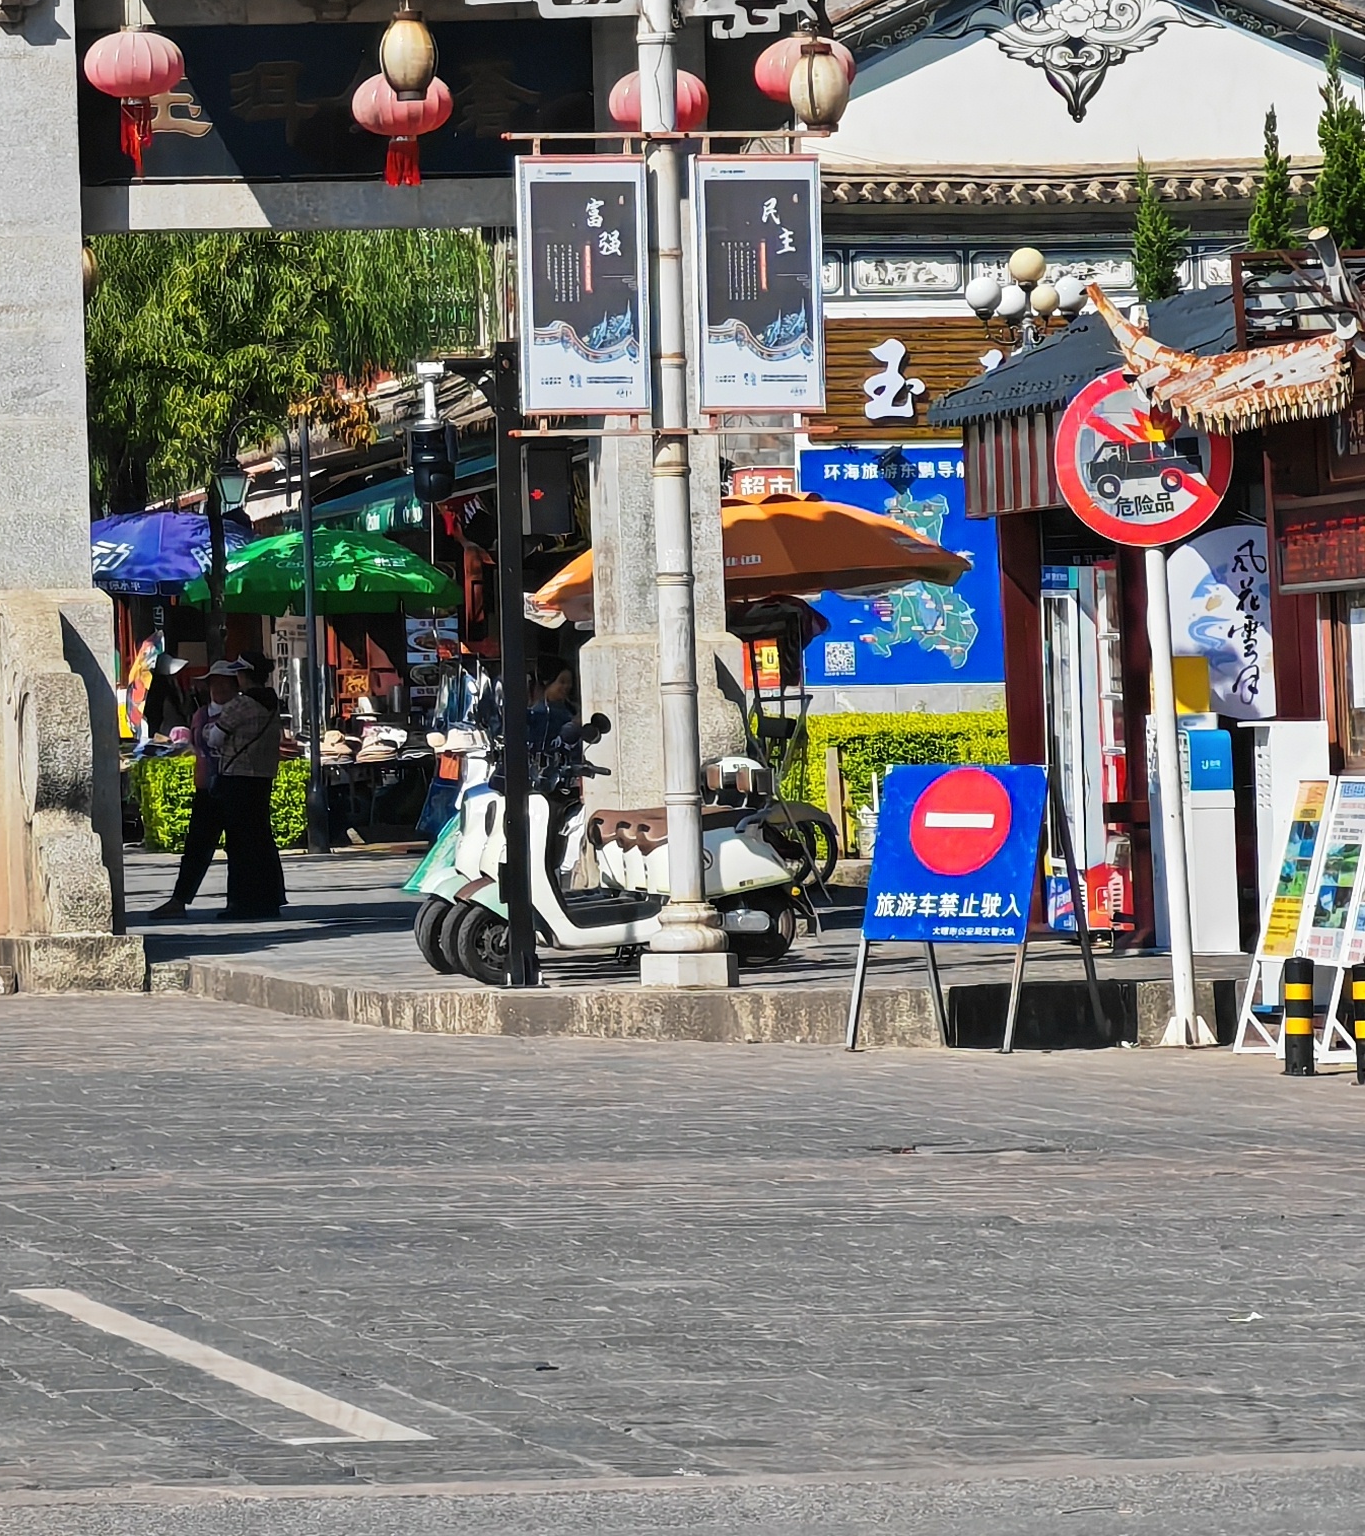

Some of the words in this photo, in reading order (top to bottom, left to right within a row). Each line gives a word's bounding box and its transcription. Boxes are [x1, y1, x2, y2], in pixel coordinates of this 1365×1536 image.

[585, 197, 622, 256] 富强
[761, 197, 797, 255] 民主
[1114, 491, 1175, 517] 危险品
[873, 892, 1022, 918] 旅游车禁止驶入
